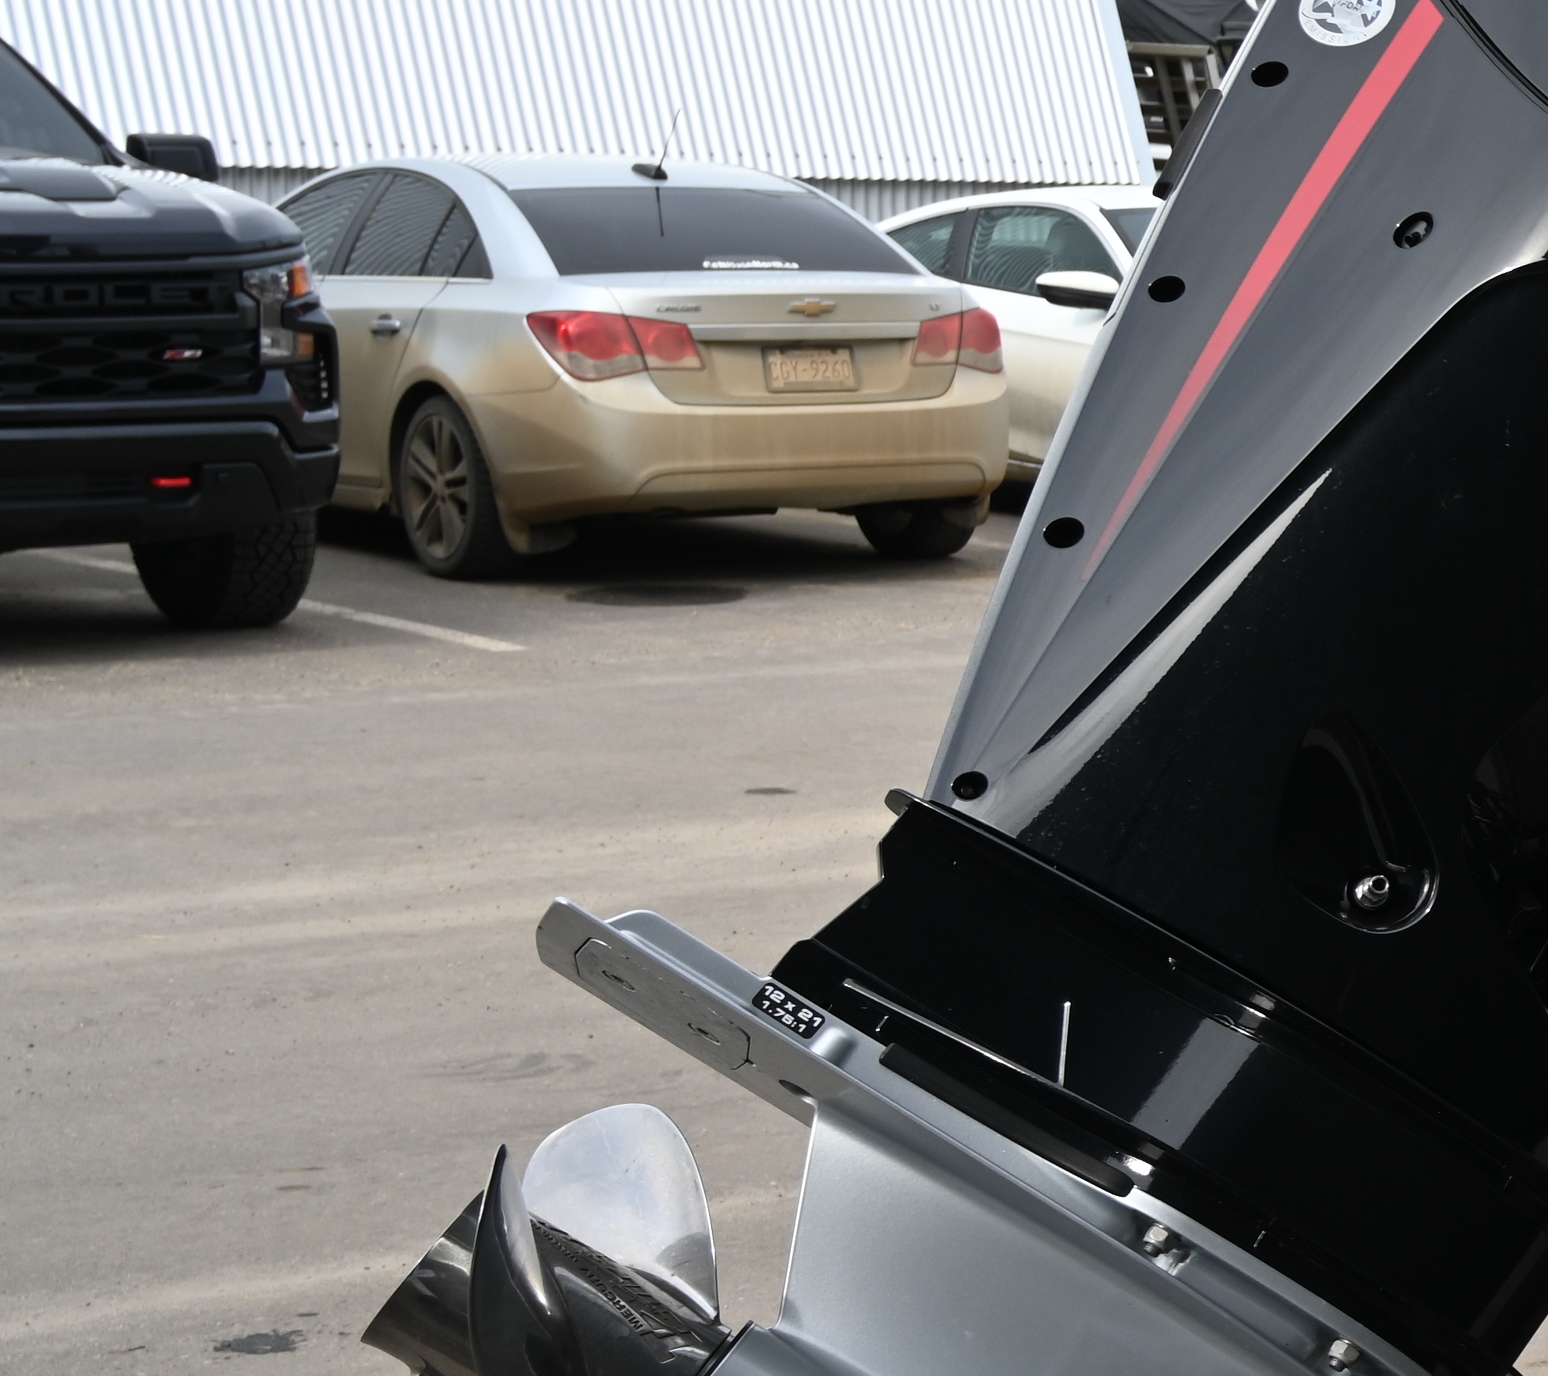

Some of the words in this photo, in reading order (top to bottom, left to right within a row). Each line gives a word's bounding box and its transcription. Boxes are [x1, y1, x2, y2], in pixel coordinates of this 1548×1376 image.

[764, 985, 786, 1004] 12
[797, 1008, 823, 1028] 21
[580, 1267, 644, 1332] MERCURY
